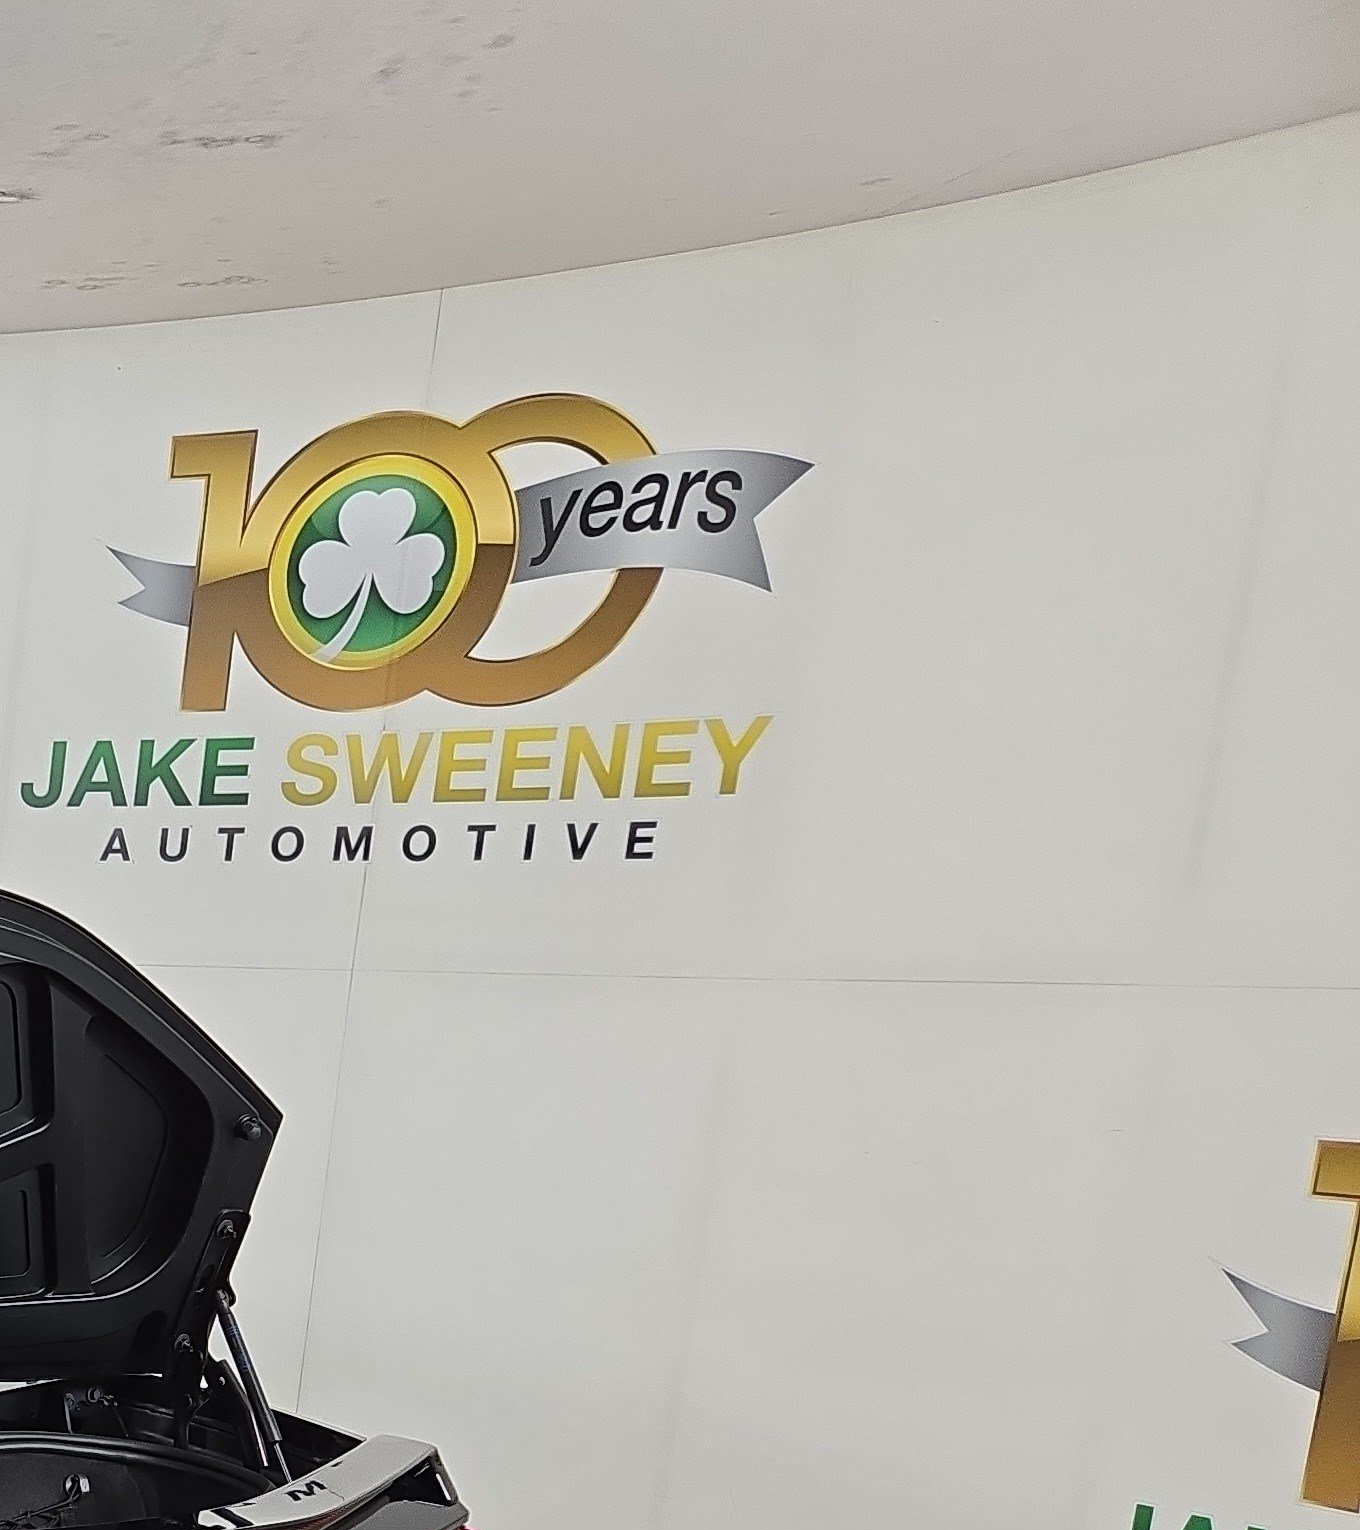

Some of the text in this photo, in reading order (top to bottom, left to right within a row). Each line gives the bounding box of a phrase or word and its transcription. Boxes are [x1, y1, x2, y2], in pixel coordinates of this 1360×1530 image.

[169, 392, 668, 713] 100
[529, 468, 743, 567] years
[20, 714, 775, 809] JAKE SWEENEY
[99, 821, 660, 863] AUTOMOTIVE
